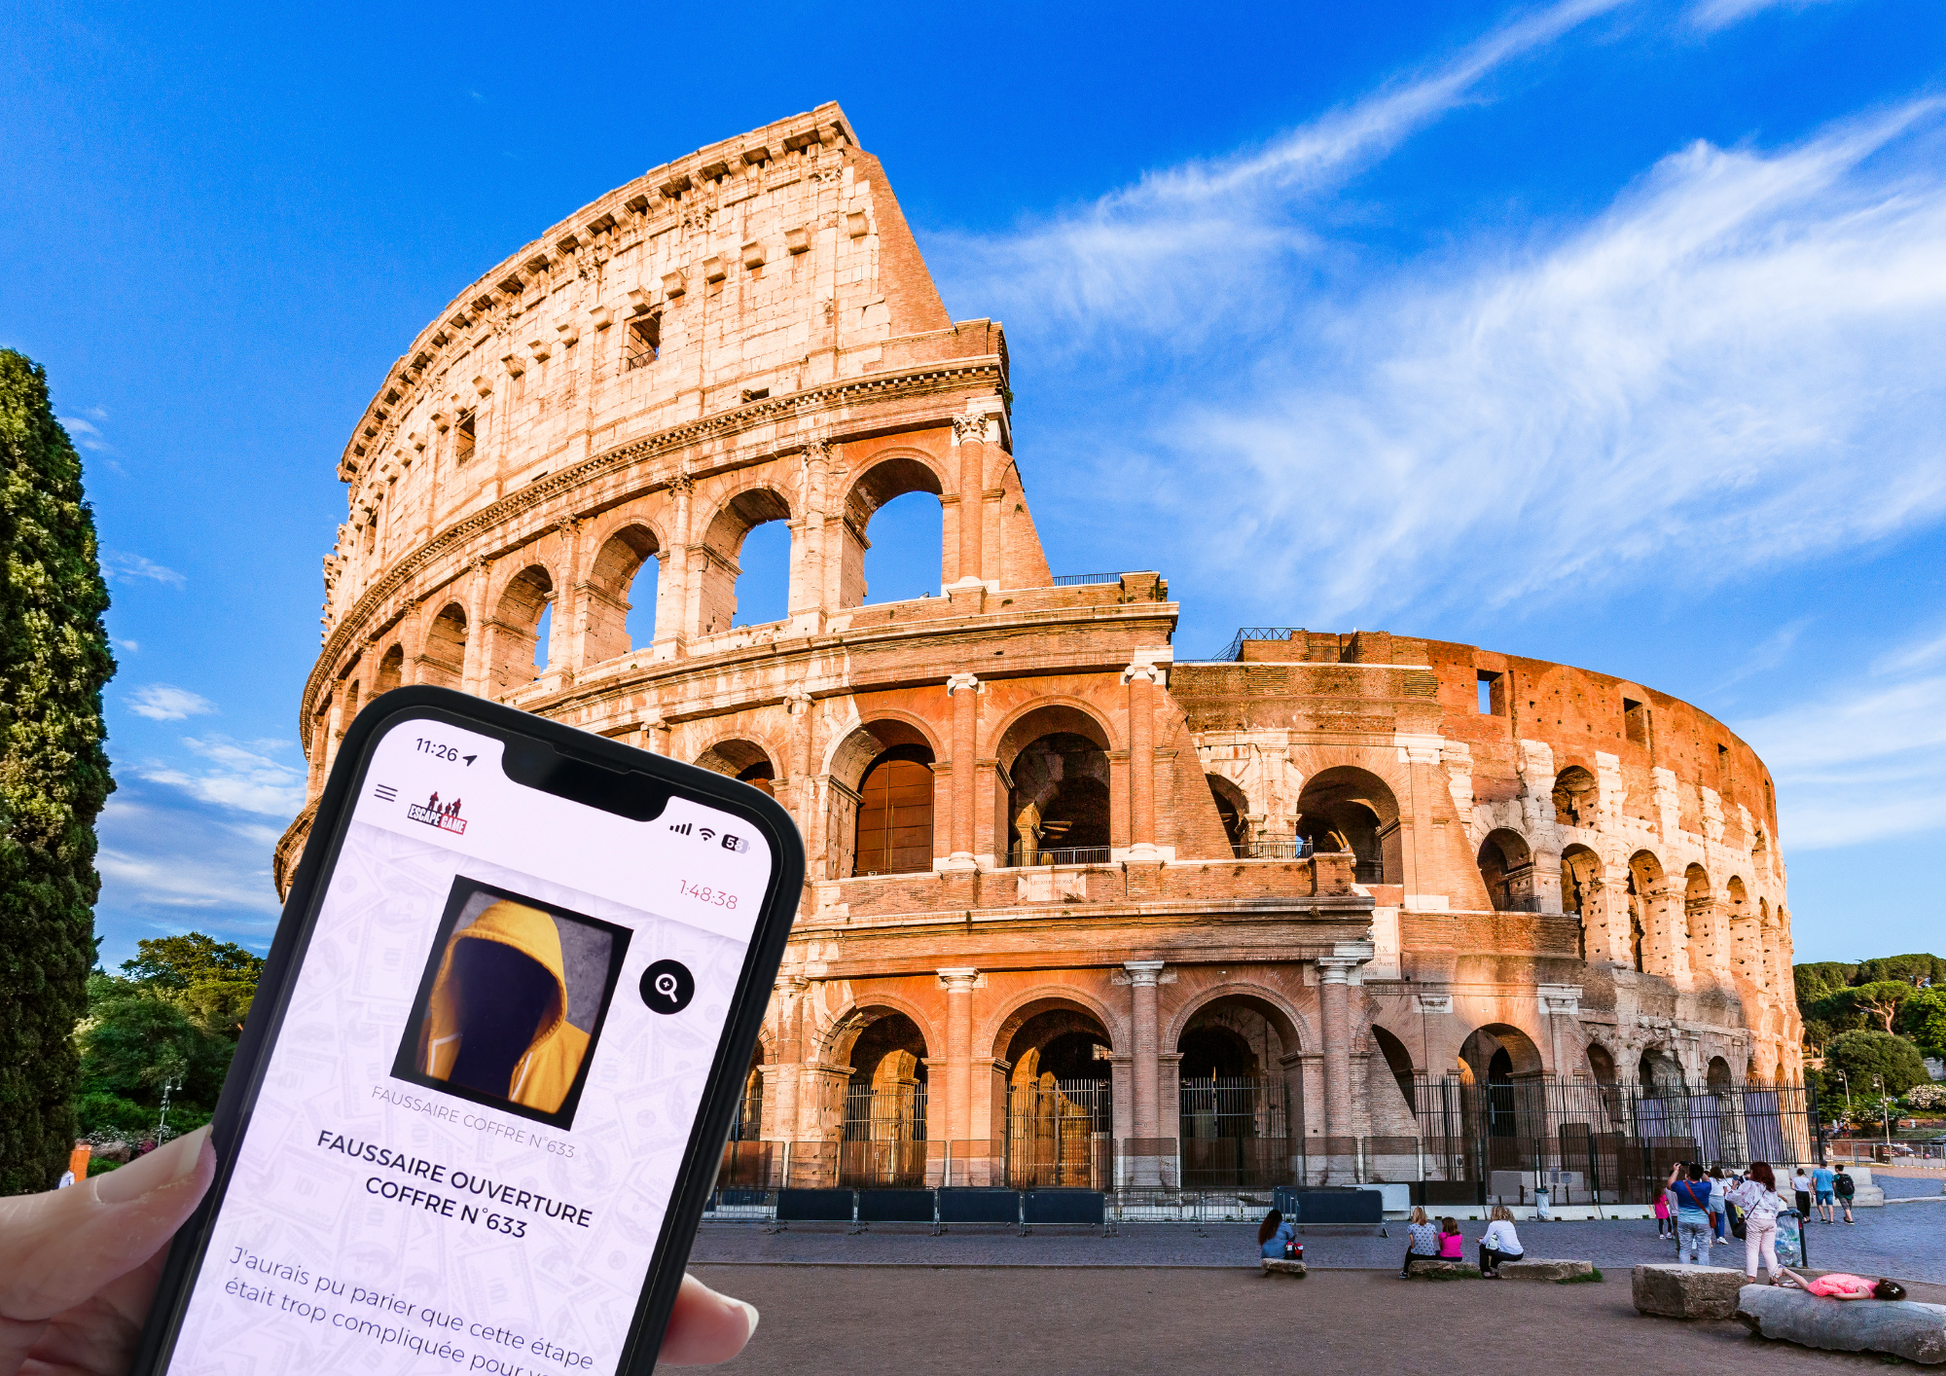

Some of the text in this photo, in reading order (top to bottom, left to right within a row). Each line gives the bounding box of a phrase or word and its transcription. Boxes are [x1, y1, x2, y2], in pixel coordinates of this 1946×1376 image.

[416, 737, 459, 762] 11:26
[408, 804, 467, 834] ESCAPE GAME
[725, 836, 744, 852] 58
[680, 879, 738, 910] 1:48:38
[371, 1085, 460, 1123] FAUSSAIRE
[463, 1114, 527, 1144] COFFRE
[317, 1129, 593, 1228] FAUSSAIRE OUVERTURE
[365, 1176, 457, 1218] COFFRE
[225, 1277, 524, 1376] était trop compliquée pour
[229, 1246, 594, 1370] J'aurais pu parier que cette étape
